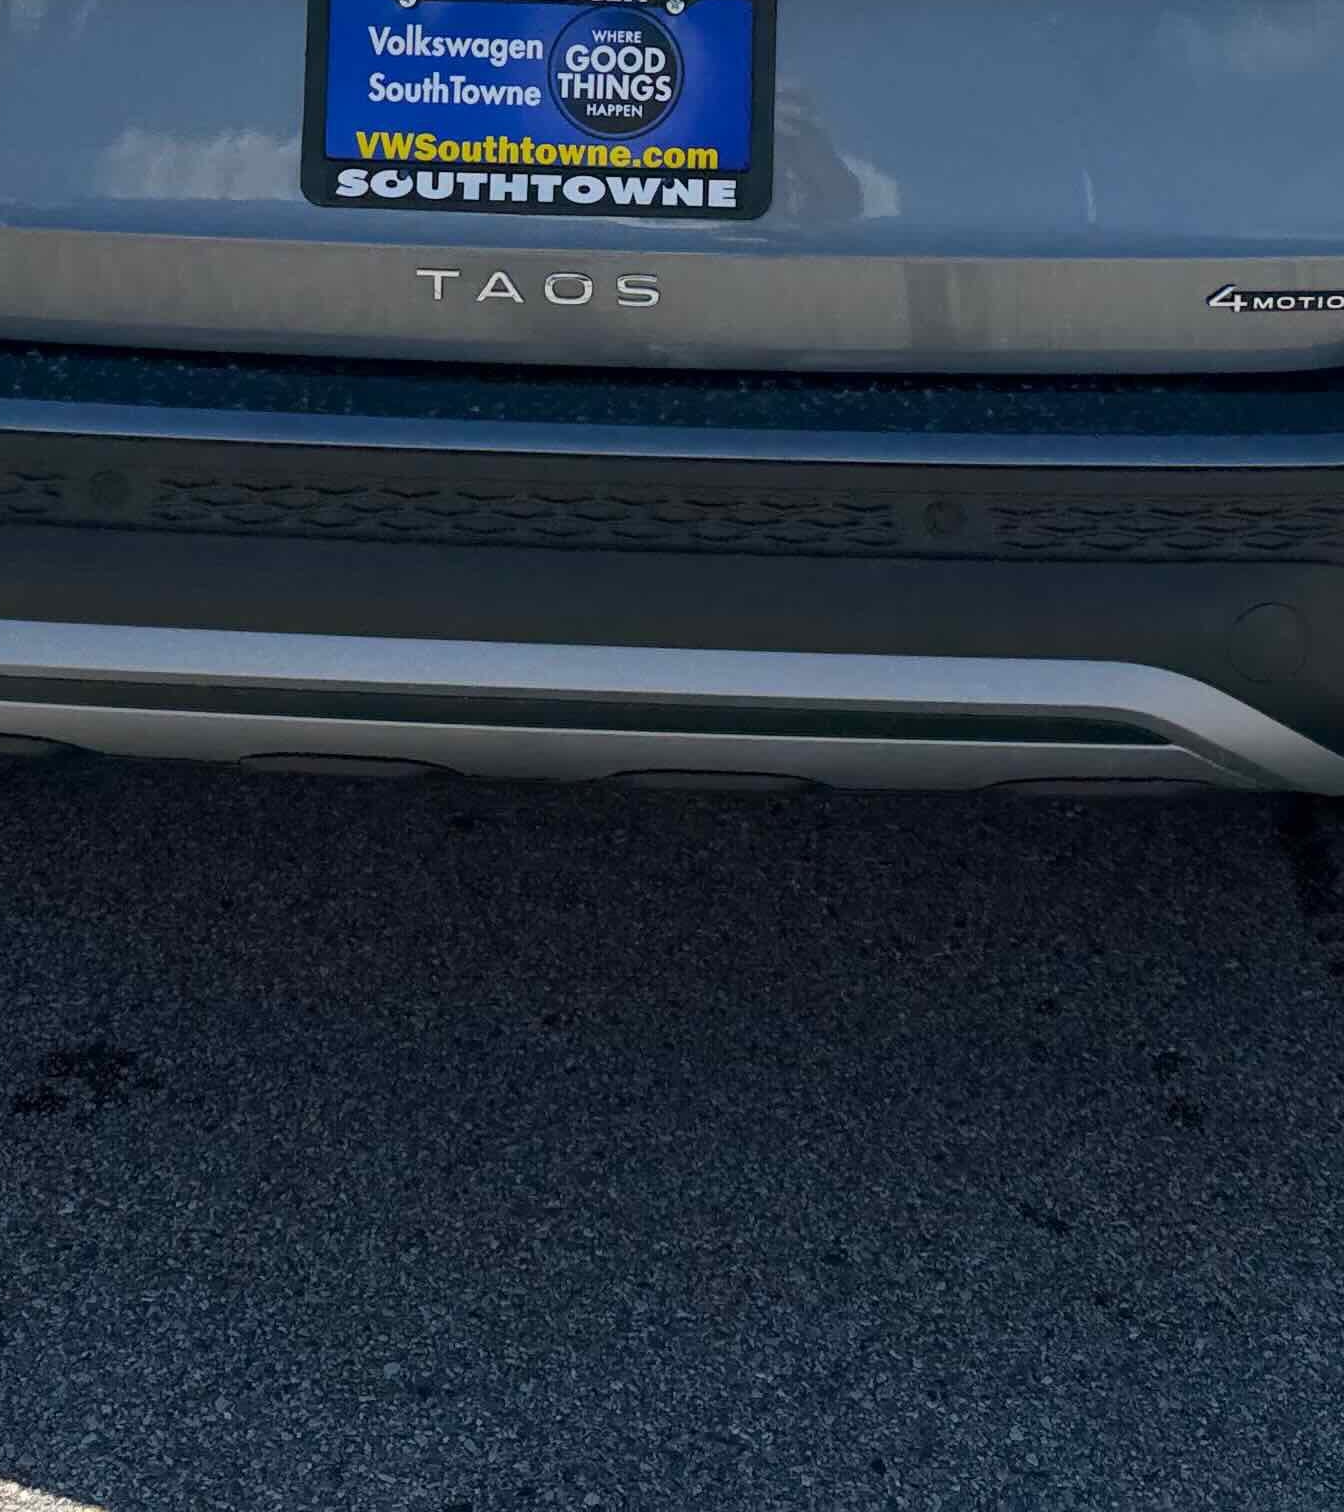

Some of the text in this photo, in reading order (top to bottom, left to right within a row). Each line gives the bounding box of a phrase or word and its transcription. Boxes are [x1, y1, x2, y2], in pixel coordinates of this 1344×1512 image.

[367, 23, 544, 68] Volkswagen
[592, 29, 642, 44] WHERE
[565, 44, 666, 74] GOOD
[556, 72, 673, 102] THINGS
[586, 103, 644, 119] HAPPEN
[356, 131, 719, 169] VWSouthtowne.com
[335, 169, 737, 208] SOUTHTOWNE
[416, 268, 660, 307] TAOS
